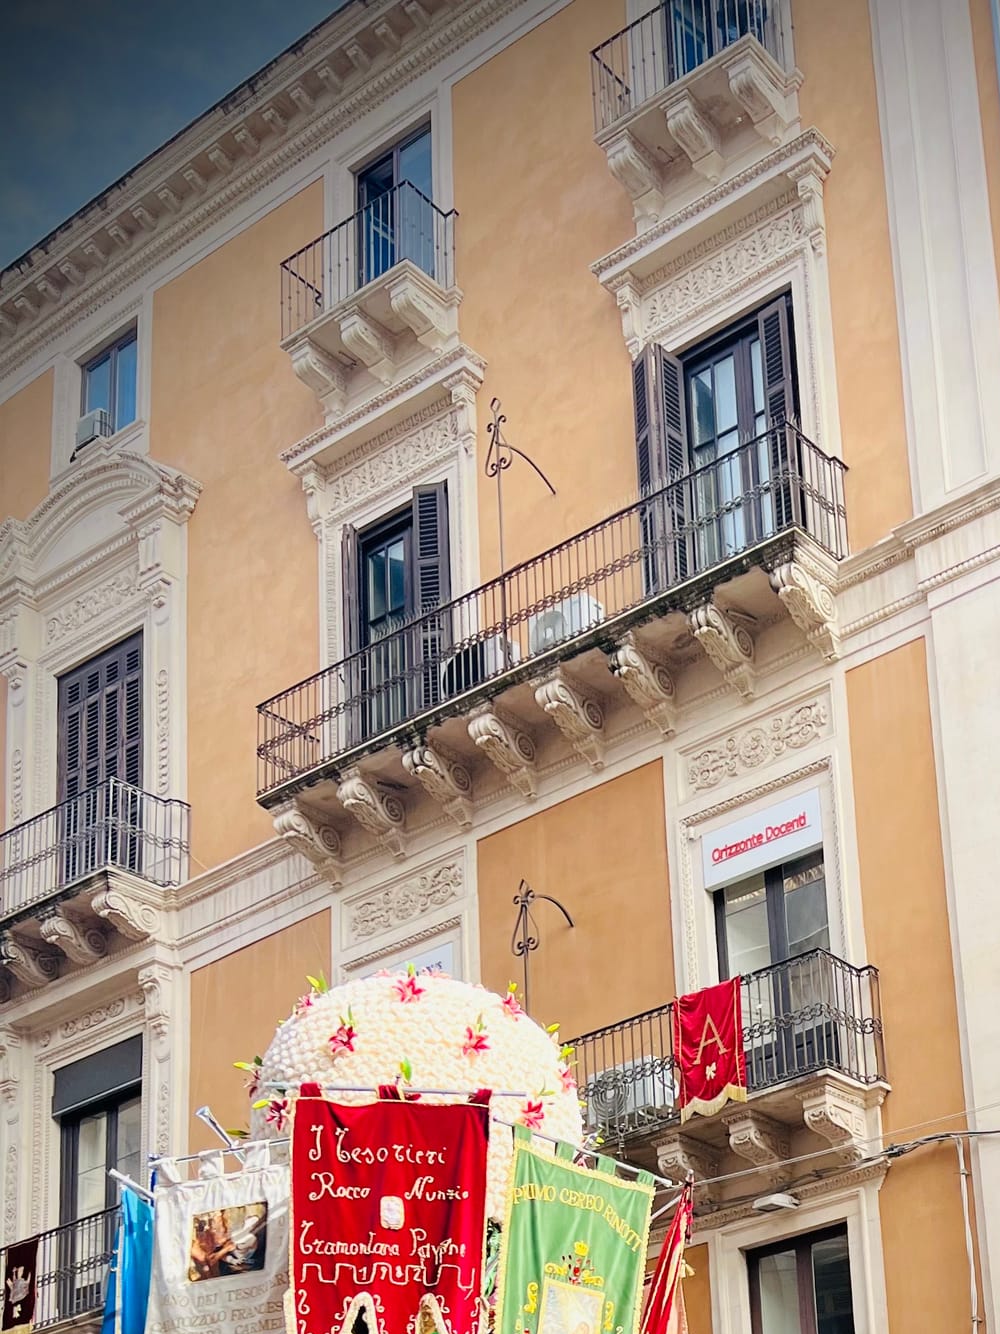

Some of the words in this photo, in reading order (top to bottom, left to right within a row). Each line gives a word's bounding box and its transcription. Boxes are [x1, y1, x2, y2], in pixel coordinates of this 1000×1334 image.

[711, 832, 763, 863] Orizzonte
[765, 812, 807, 840] Docenti
[692, 1013, 731, 1065] A
[308, 1172, 371, 1201] Rocco
[404, 1176, 469, 1202] Nunzio
[512, 1183, 556, 1205] PRIMO
[559, 1187, 605, 1212] CEREO
